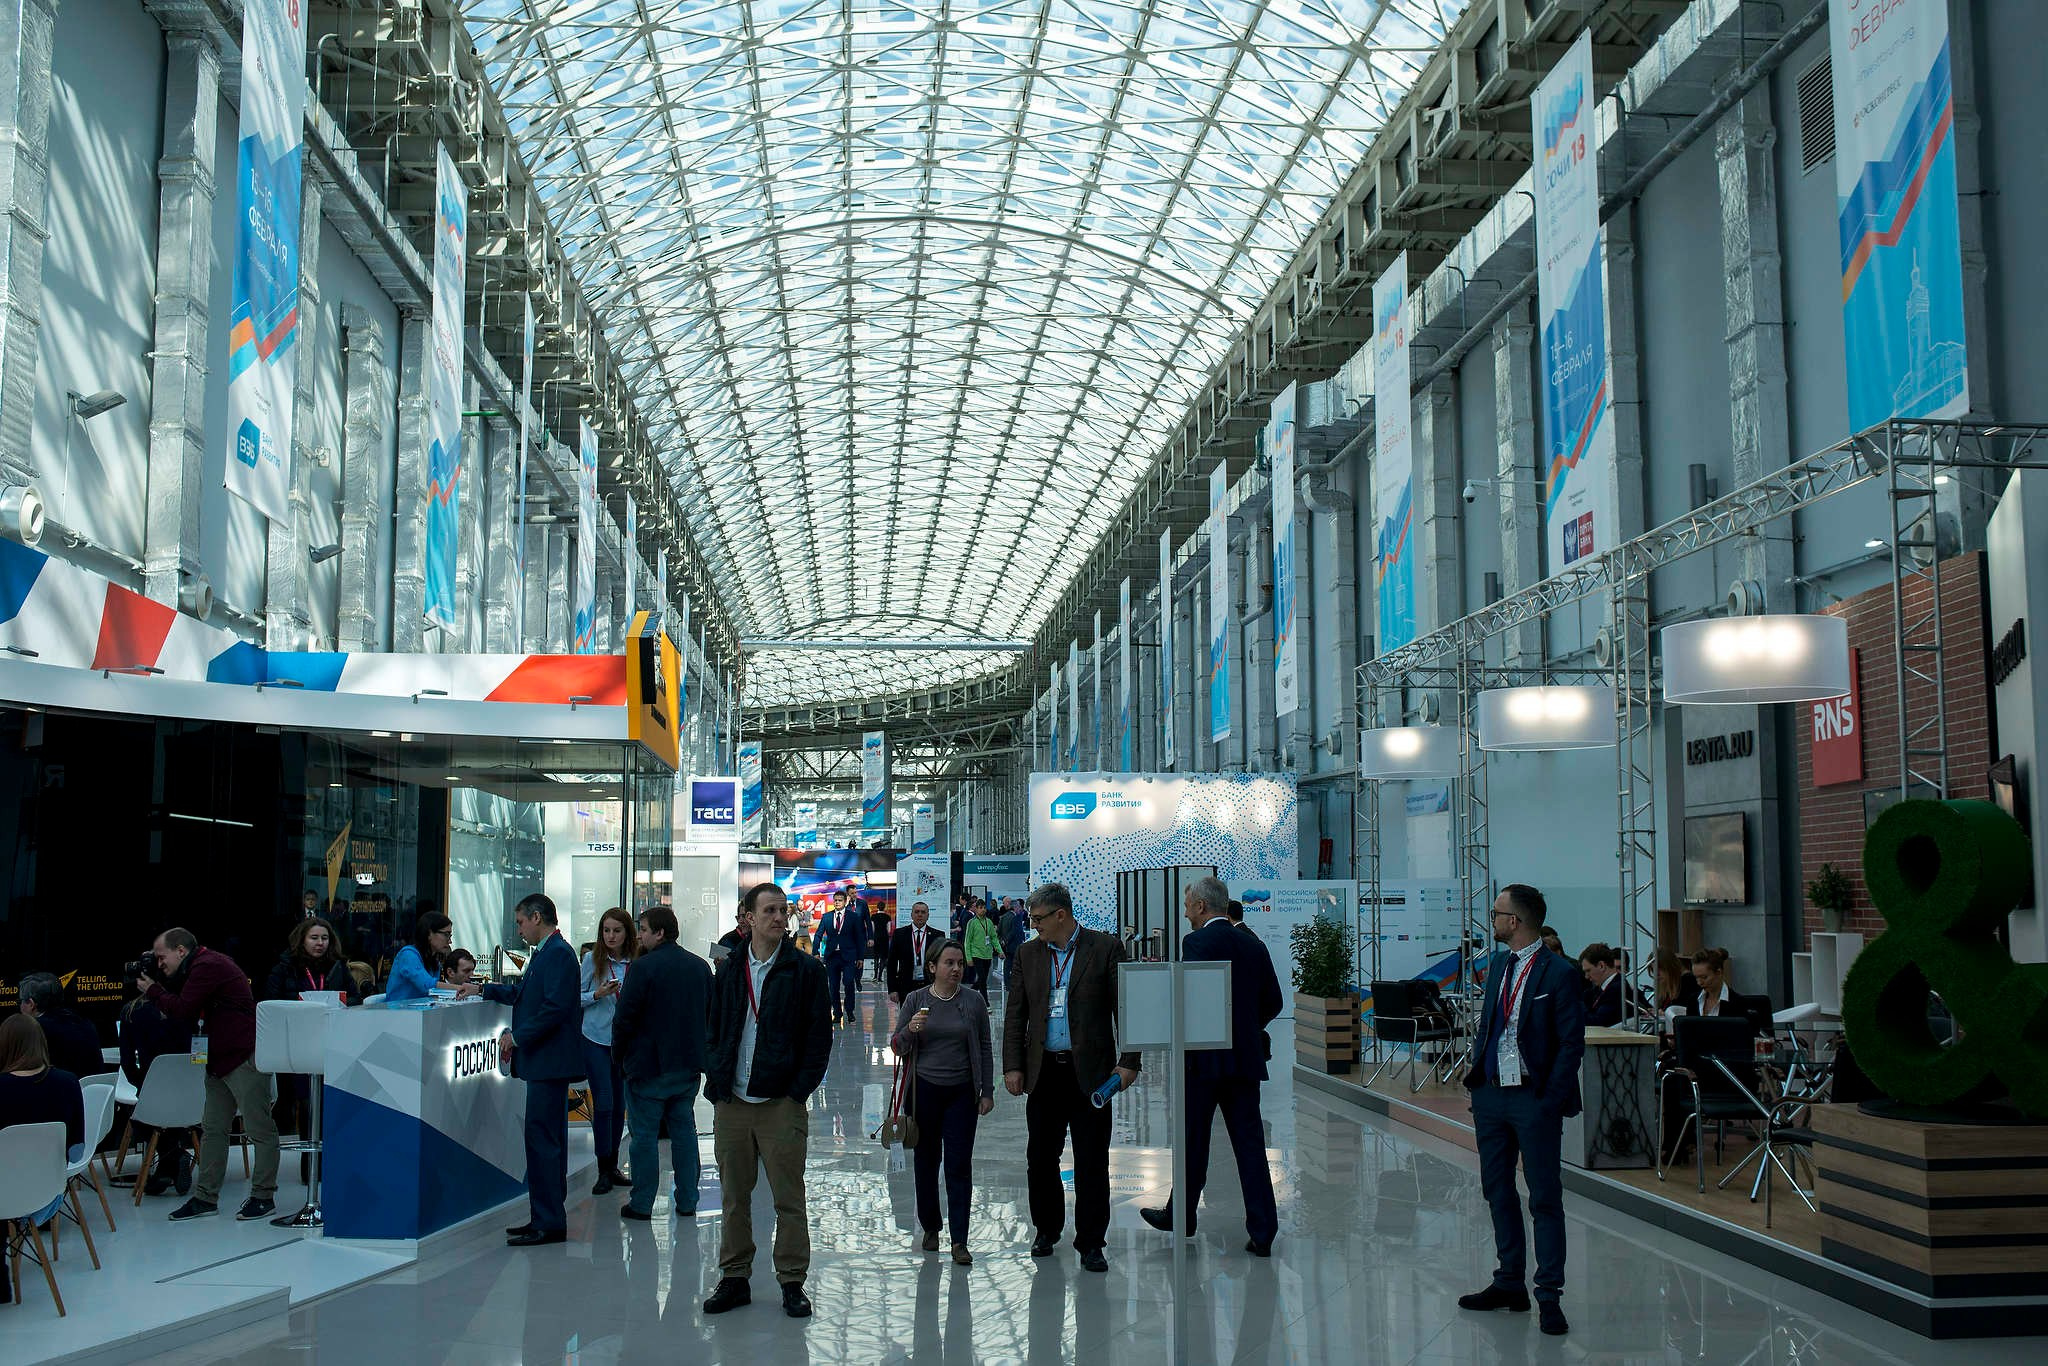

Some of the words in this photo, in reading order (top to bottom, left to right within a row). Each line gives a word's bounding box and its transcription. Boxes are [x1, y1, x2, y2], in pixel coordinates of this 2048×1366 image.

[1545, 152, 1571, 193] СОЧИ
[1572, 133, 1585, 167] 18
[248, 206, 288, 269] ФЕВРАЛЯ
[1395, 327, 1404, 351] 18
[1551, 344, 1593, 386] ФЕВРАЛЯ
[240, 434, 256, 461] ВЭБ
[1813, 696, 1854, 742] RNS
[1686, 730, 1753, 766] LENTA.RU
[1101, 791, 1123, 799] БАНК
[1101, 800, 1143, 808] РАЗВИТИЯ
[1055, 803, 1086, 815] ВЭБ
[1278, 887, 1322, 896] РОССИЙСКИ
[805, 900, 825, 914] 24
[0, 986, 18, 994] TOLD
[77, 983, 92, 991] THE
[95, 982, 123, 990] UNTOLD
[455, 1038, 497, 1079] РОССИЯ
